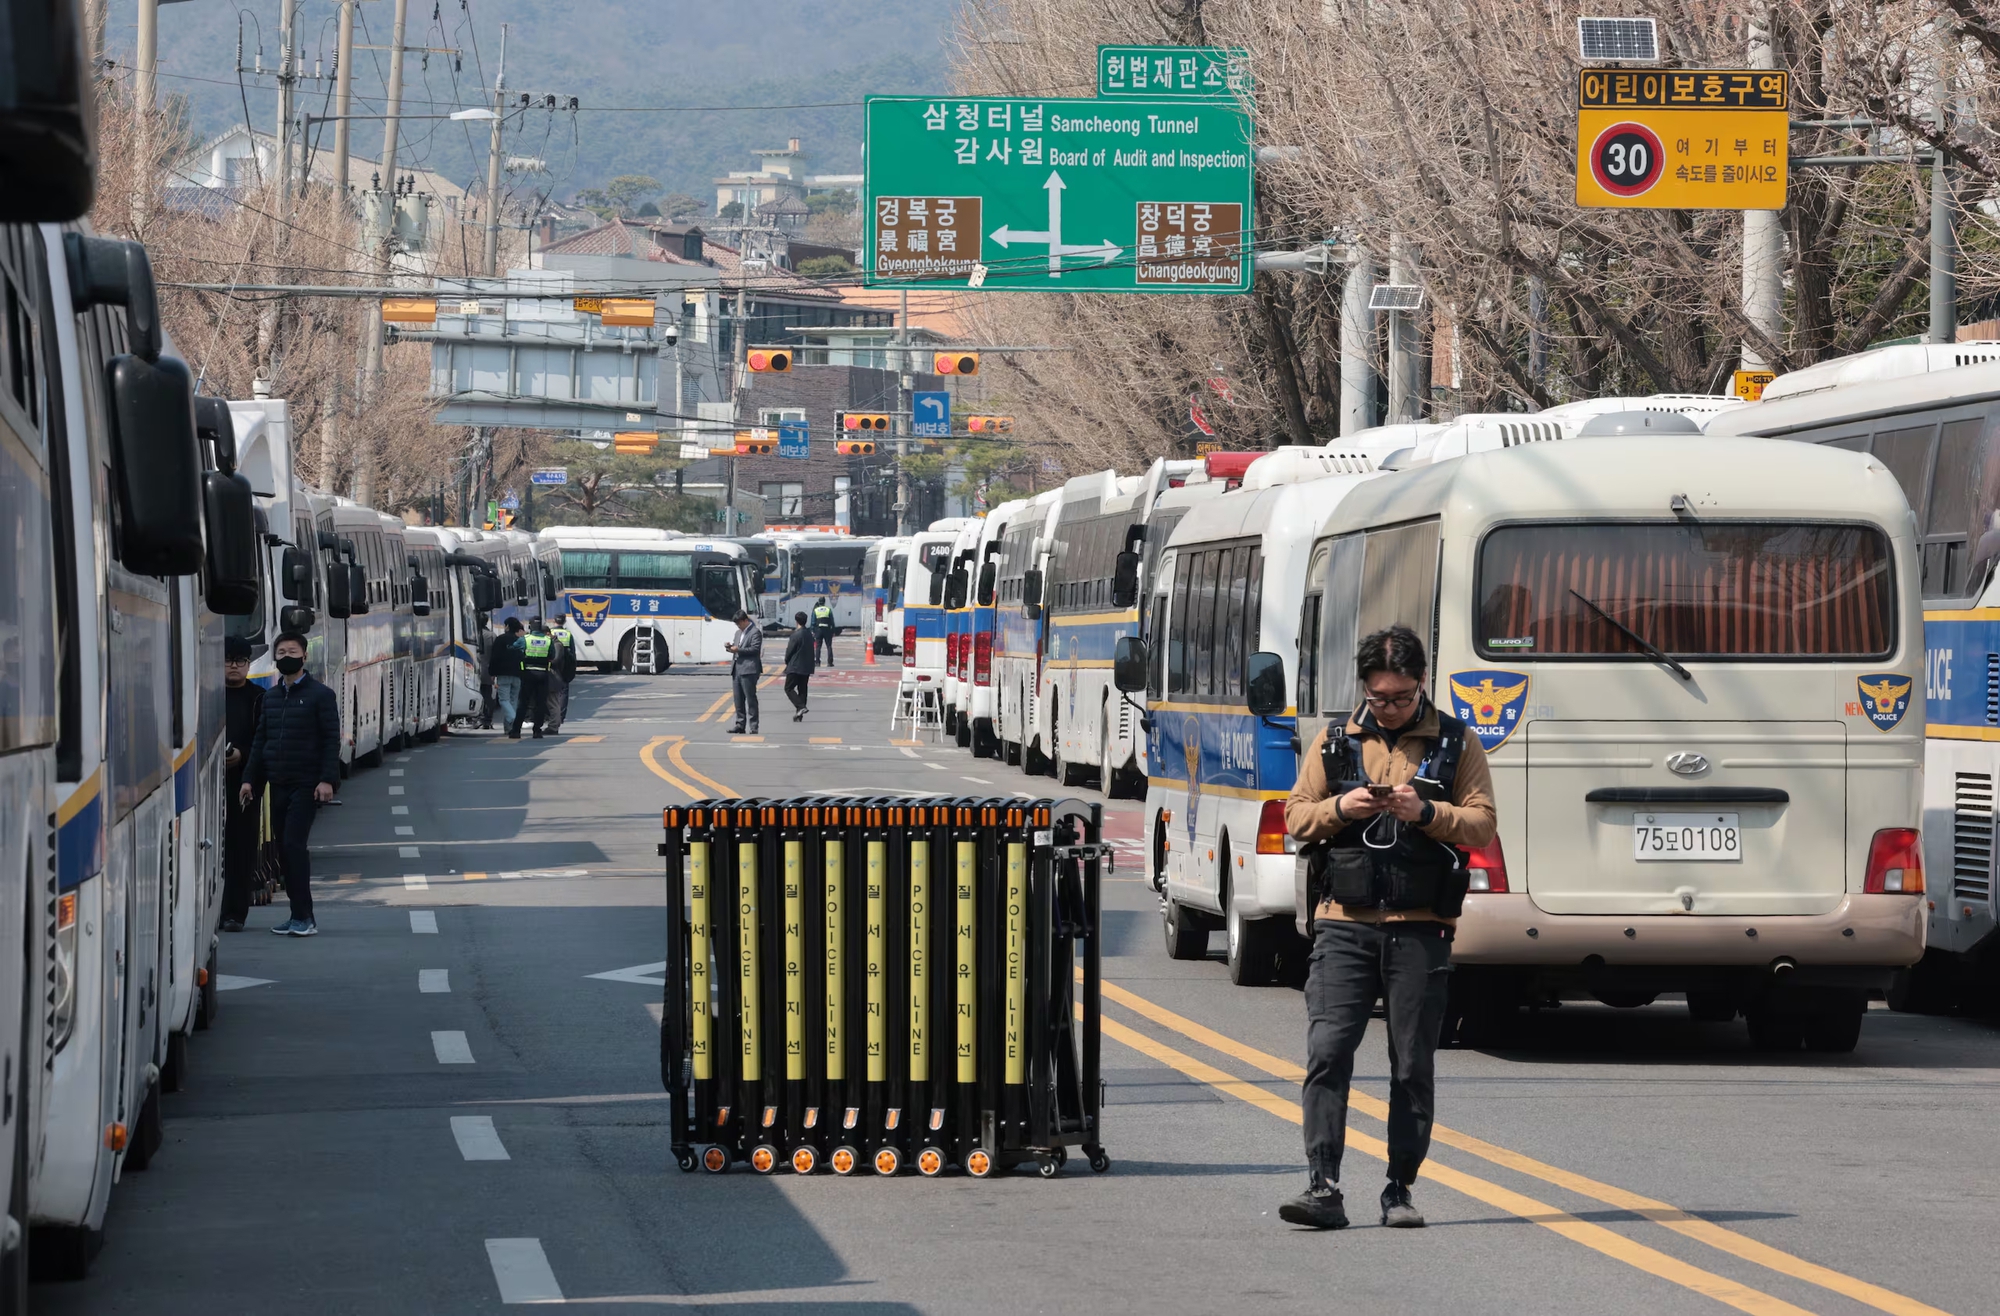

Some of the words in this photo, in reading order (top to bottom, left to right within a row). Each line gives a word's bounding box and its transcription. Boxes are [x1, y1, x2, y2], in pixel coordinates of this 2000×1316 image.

[1585, 73, 1783, 106] 어린이보호구역
[922, 103, 1044, 132] 삼청터널
[1050, 114, 1141, 137] Samcheong
[1147, 115, 1199, 135] Tunnel
[954, 137, 1044, 166] 감사원
[1049, 148, 1088, 167] Board
[1092, 149, 1106, 167] of
[1113, 149, 1148, 168] Audit
[1151, 150, 1176, 168] and
[1179, 150, 1246, 171] Inspection
[1607, 143, 1648, 176] 30
[1676, 137, 1777, 157] 여기부터
[1675, 164, 1718, 184] 속도를
[1721, 164, 1778, 184] 줄이시오
[879, 198, 957, 227] 경복궁
[1140, 203, 1213, 233] 창덕궁
[878, 229, 957, 252] 景福宮
[1139, 234, 1213, 258] 昌德宮
[1139, 261, 1239, 283] Changdeokgung
[915, 422, 949, 437] 비보호
[780, 445, 808, 457] 비보호
[630, 599, 660, 612] 경찰
[1925, 648, 1953, 700] LICE
[1460, 708, 1470, 720] 경
[1505, 708, 1517, 720] 찰
[1872, 713, 1898, 721] POLICE
[1232, 732, 1254, 770] POLICE
[1636, 827, 1737, 851] 75모0108
[741, 886, 752, 977] POLICE
[826, 884, 837, 976] POLICE
[912, 885, 923, 977] POLICE
[1008, 887, 1020, 979] POLICE
[691, 884, 707, 1055] 질서유지선
[785, 884, 800, 1055] 질서유지선
[867, 884, 880, 1057] 질서유지선
[957, 885, 971, 1058] 질서유지선
[743, 995, 752, 1055] LINE
[827, 994, 837, 1054] LINE
[912, 995, 922, 1056] LINE
[1007, 998, 1017, 1059] LINE
